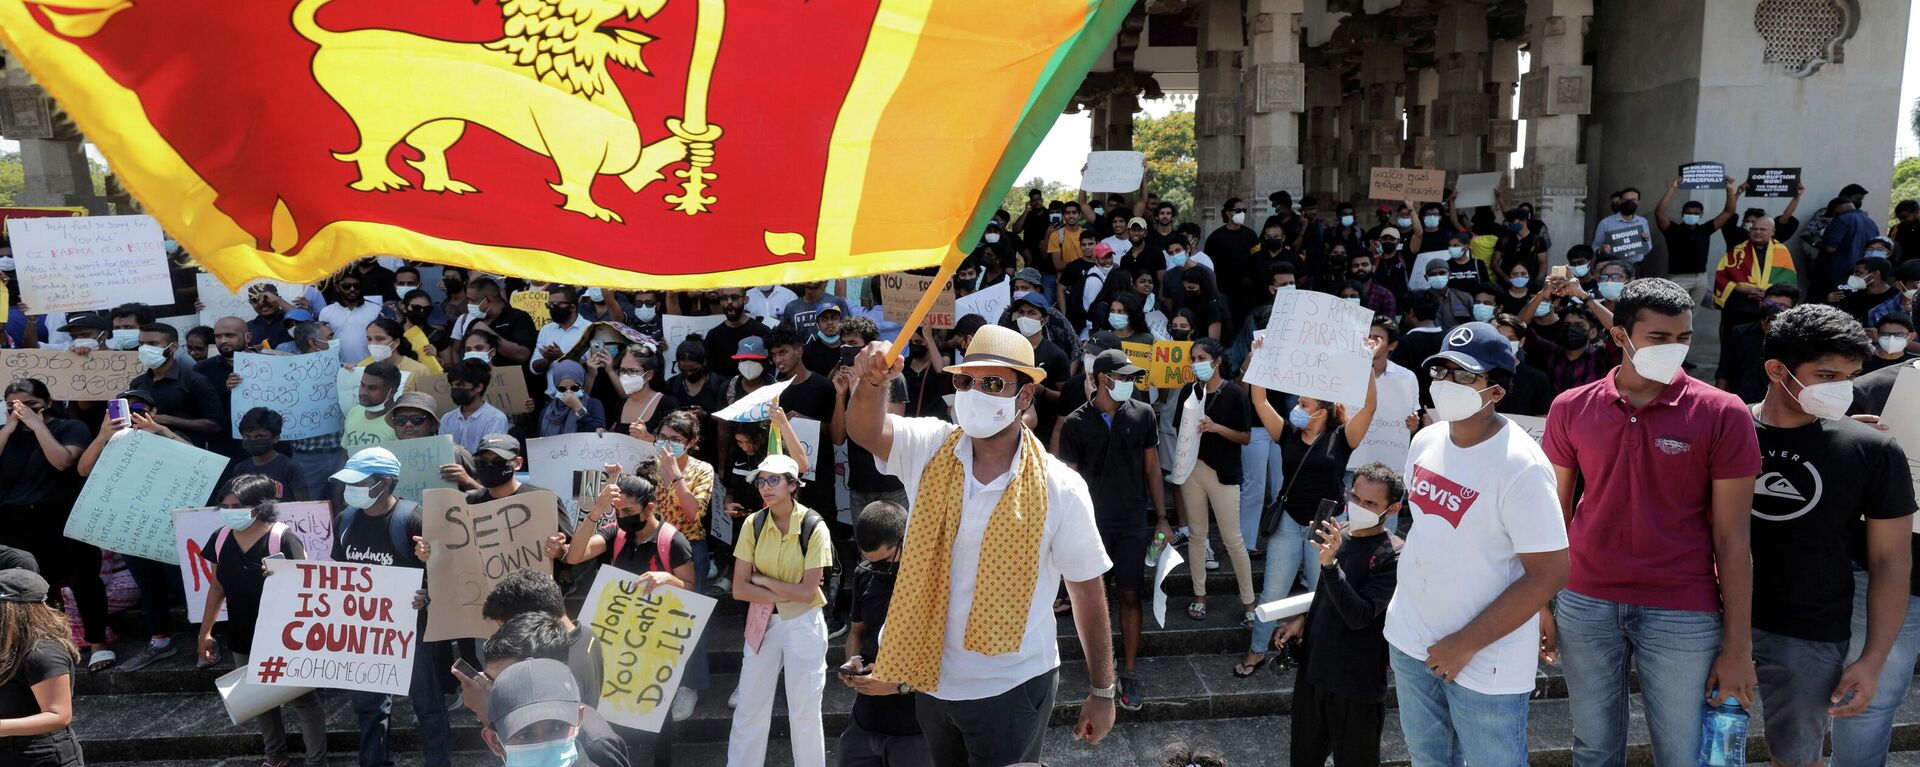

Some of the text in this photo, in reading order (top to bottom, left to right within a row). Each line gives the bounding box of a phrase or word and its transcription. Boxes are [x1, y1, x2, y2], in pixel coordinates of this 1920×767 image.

[1611, 229, 1639, 240] ENOUGH
[1612, 241, 1643, 253] ENOUGH!
[50, 247, 95, 259] KARMA
[882, 275, 903, 290] YOU
[528, 291, 549, 301] COU
[1274, 291, 1320, 317] LET'S
[1267, 317, 1297, 343] THE
[1123, 348, 1153, 361] ESSINGS
[1155, 345, 1183, 364] NO
[1258, 346, 1330, 371] OFF OUR
[1255, 366, 1343, 393] PARADISE
[1768, 449, 1801, 462] VER
[83, 505, 104, 543] SECURE
[101, 484, 117, 504] OUR
[123, 505, 141, 535] WANT
[283, 511, 331, 541] ricity
[148, 517, 164, 542] NEED
[345, 543, 394, 566] kindness
[480, 540, 544, 581] OWN
[296, 563, 374, 593] THIS
[294, 593, 395, 623] IS OUR
[590, 578, 638, 647] Home
[281, 620, 415, 660] COUNTRY
